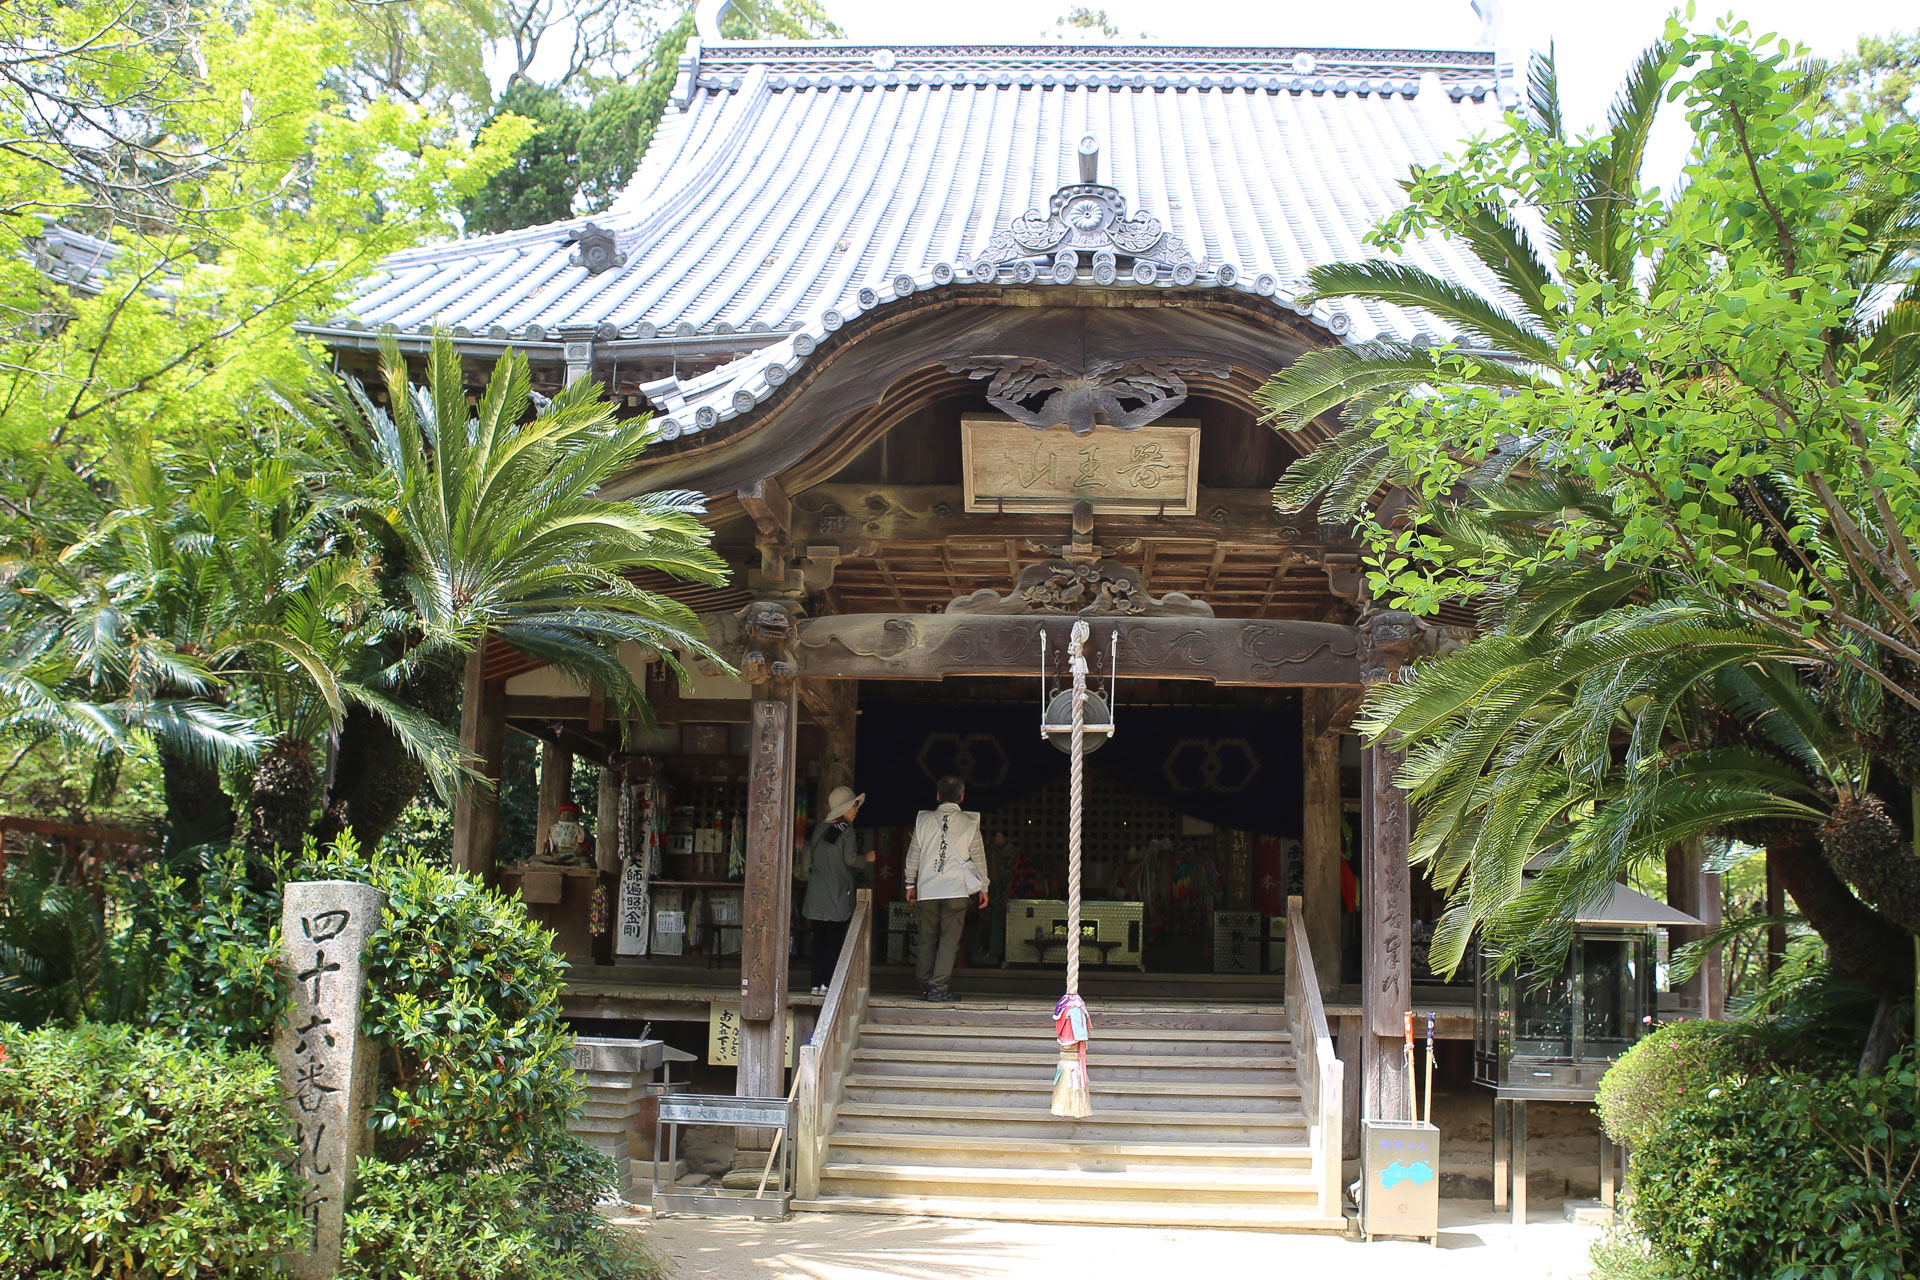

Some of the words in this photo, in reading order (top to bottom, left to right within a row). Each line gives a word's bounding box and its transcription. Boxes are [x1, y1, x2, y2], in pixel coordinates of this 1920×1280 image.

[283, 908, 351, 1254] 四十六番札所
